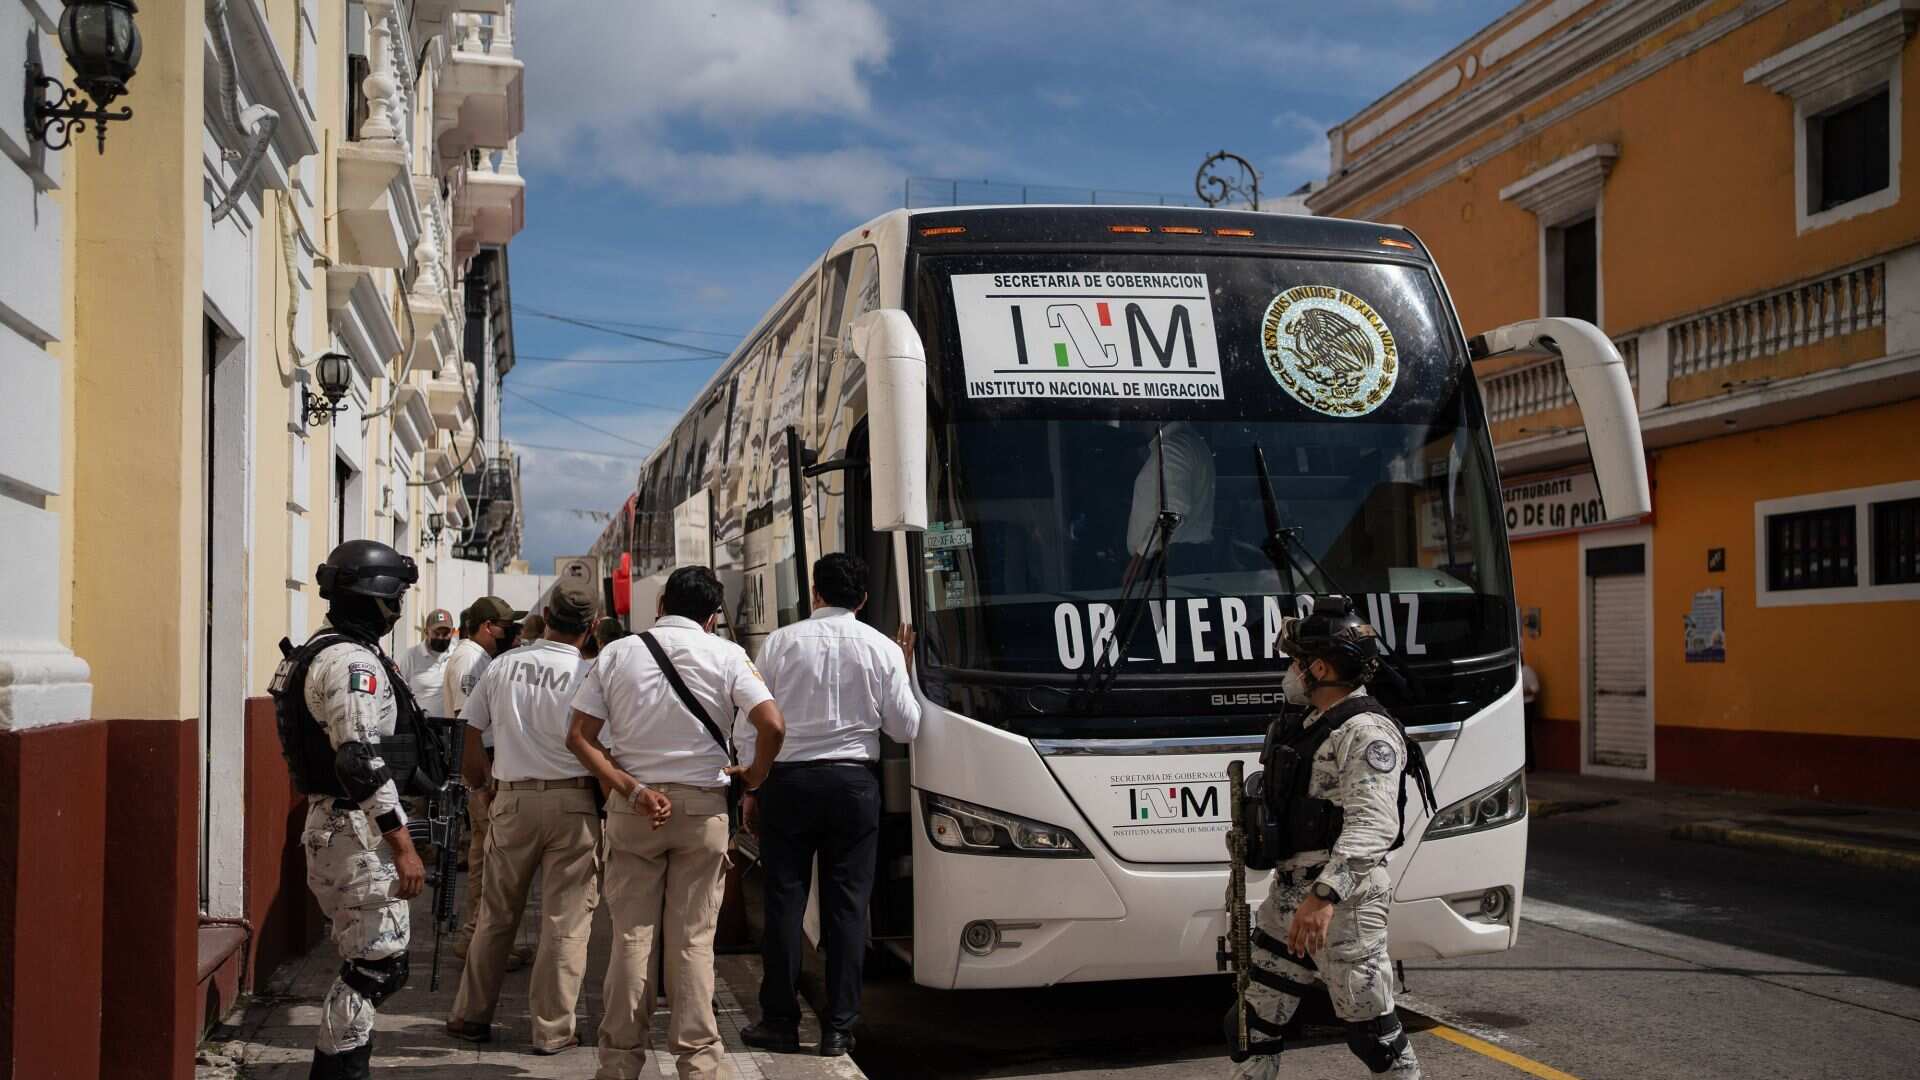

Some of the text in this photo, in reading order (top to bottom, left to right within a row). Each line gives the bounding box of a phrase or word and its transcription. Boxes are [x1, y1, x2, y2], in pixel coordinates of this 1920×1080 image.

[994, 275, 1204, 288] SECRETARIA DE GOBERNACION
[1288, 286, 1336, 303] UNIDOS
[1010, 302, 1198, 369] INM
[970, 381, 1220, 398] INSTITUTO NACIONAL DE MIGRACION
[1502, 478, 1573, 503] ESTAURANTE
[1524, 503, 1545, 526] DE
[1550, 503, 1566, 527] LA
[1148, 593, 1427, 664] VERAUZ
[1211, 693, 1285, 706] BUSSCA
[1110, 770, 1229, 783] SECRETARIA DE GOBERNACIO
[1129, 786, 1219, 820] INM
[1113, 823, 1232, 837] INSTITUTO NACIONAL DE MIGRACIO
